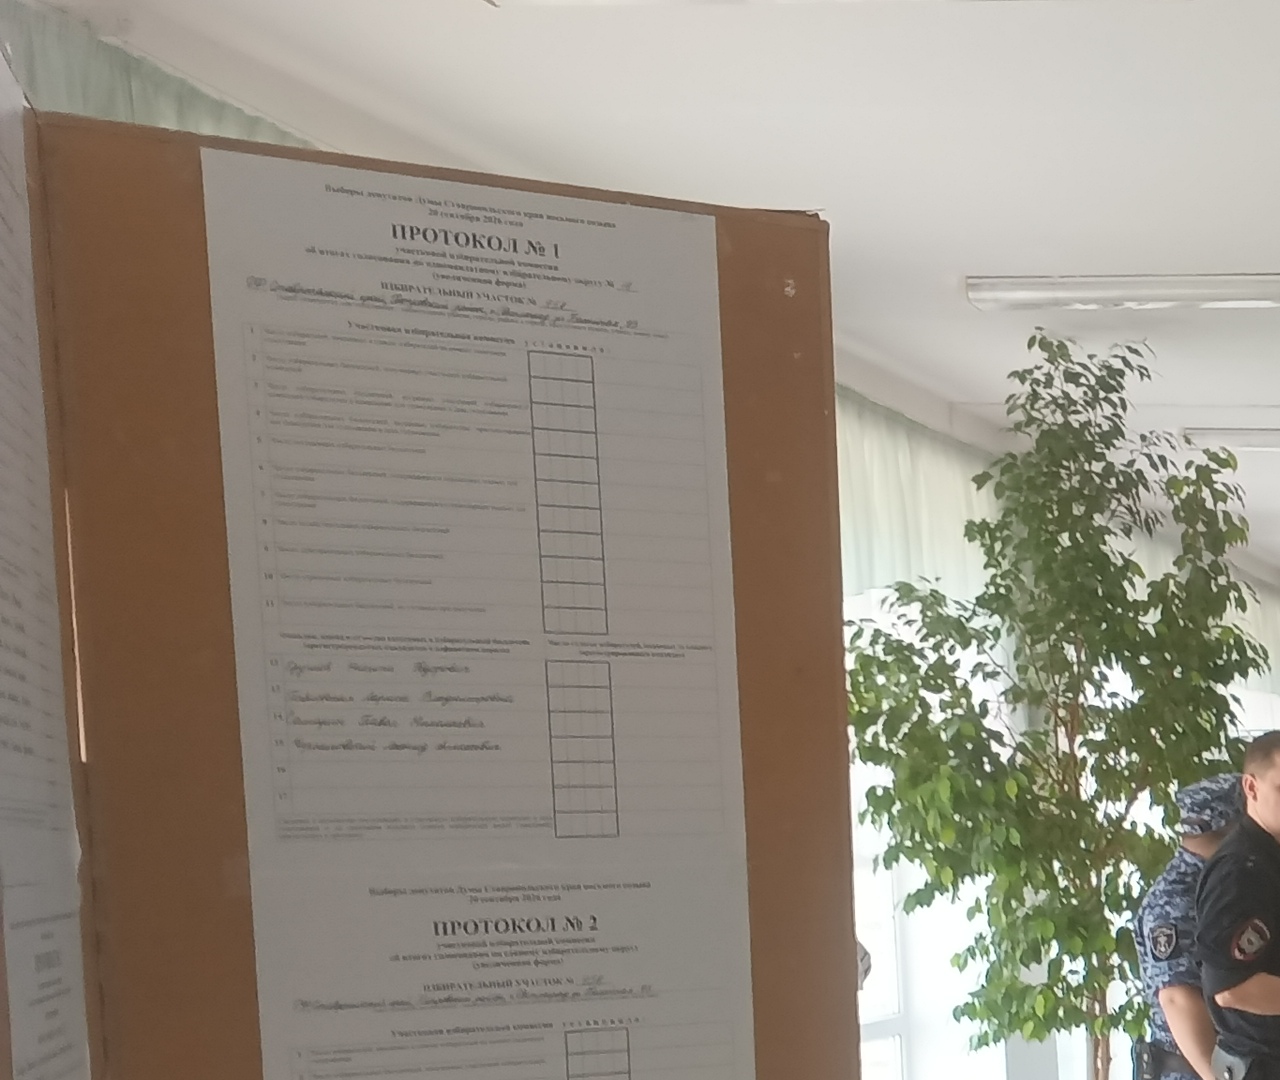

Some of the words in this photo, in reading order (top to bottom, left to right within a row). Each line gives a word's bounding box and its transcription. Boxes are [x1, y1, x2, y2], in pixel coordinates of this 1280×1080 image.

[391, 222, 518, 254] ПРОТОКОЛ
[524, 239, 546, 257] №
[553, 243, 560, 259] 1
[433, 917, 556, 937] ПРОТОКОЛ
[562, 915, 583, 932] №
[588, 914, 599, 931] 2
